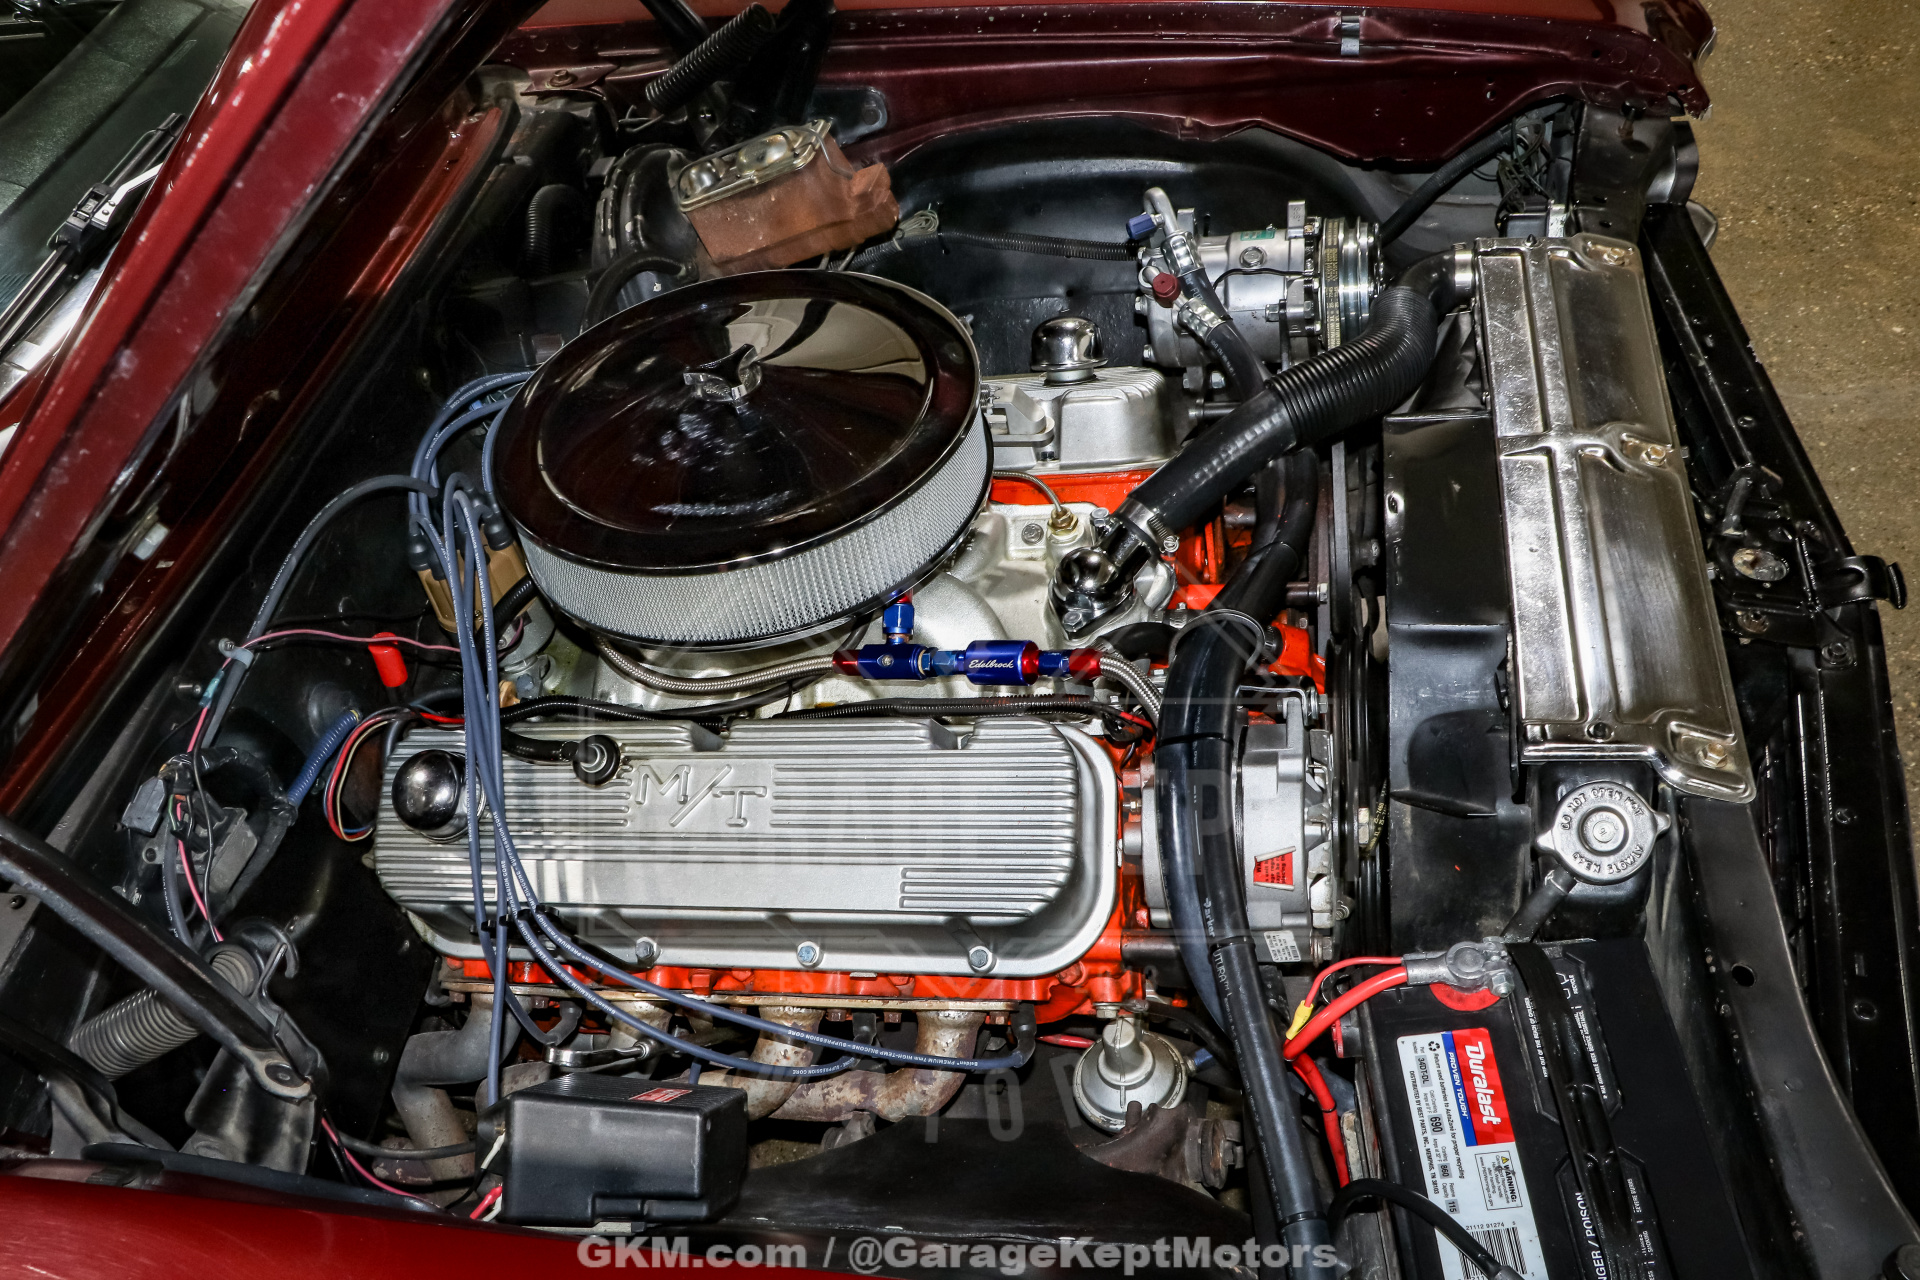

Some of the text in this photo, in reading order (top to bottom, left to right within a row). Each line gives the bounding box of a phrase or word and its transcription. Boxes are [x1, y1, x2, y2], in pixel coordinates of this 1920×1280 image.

[968, 659, 1015, 669] Edelbrock
[635, 764, 768, 828] M/T
[493, 810, 501, 827] CORE
[1561, 814, 1572, 830] DO
[1568, 793, 1587, 813] NOT
[1591, 787, 1623, 801] OPEN
[1624, 796, 1646, 817] HOT
[498, 827, 516, 867] SUPPRESSION
[1572, 844, 1645, 875] OPEN SLOWLY
[516, 871, 531, 896] SILICONE
[547, 925, 558, 938] 7mm
[557, 937, 582, 957] PREMIUM
[536, 948, 561, 974] HIGH-TEMP
[561, 972, 571, 984] 7mm
[1568, 974, 1578, 995] RECYCLE
[571, 981, 596, 1002] PREMIUM
[1524, 997, 1533, 1018] CHILDREN
[787, 1029, 804, 1038] CORE
[805, 1035, 847, 1047] SUPPRESSION
[1531, 1025, 1539, 1039] REACH
[852, 1044, 879, 1054] SILICONE
[879, 1050, 913, 1060] HIGH-TEMP
[808, 1065, 840, 1074] SUPPRESSION
[927, 1057, 955, 1065] PREMIUM
[1417, 1057, 1429, 1084] 34DT-DL
[1447, 1051, 1461, 1086] PROVEN
[1409, 1070, 1420, 1099] DISTRIBUTED
[1465, 1041, 1502, 1126] Duralast
[1416, 1106, 1424, 1118] BEST
[1433, 1053, 1441, 1068] Return
[1440, 1081, 1448, 1100] batteries
[1455, 1156, 1465, 1179] recycling
[1419, 1119, 1428, 1136] PARTS,
[1430, 1116, 1443, 1133] 690
[1425, 1148, 1434, 1172] MEMPHIS,
[1440, 1164, 1450, 1177] 860
[1431, 1179, 1439, 1195] 38103
[1504, 1165, 1517, 1203] WARNING:
[1448, 1201, 1457, 1213] 115
[1575, 1192, 1596, 1237] POISON
